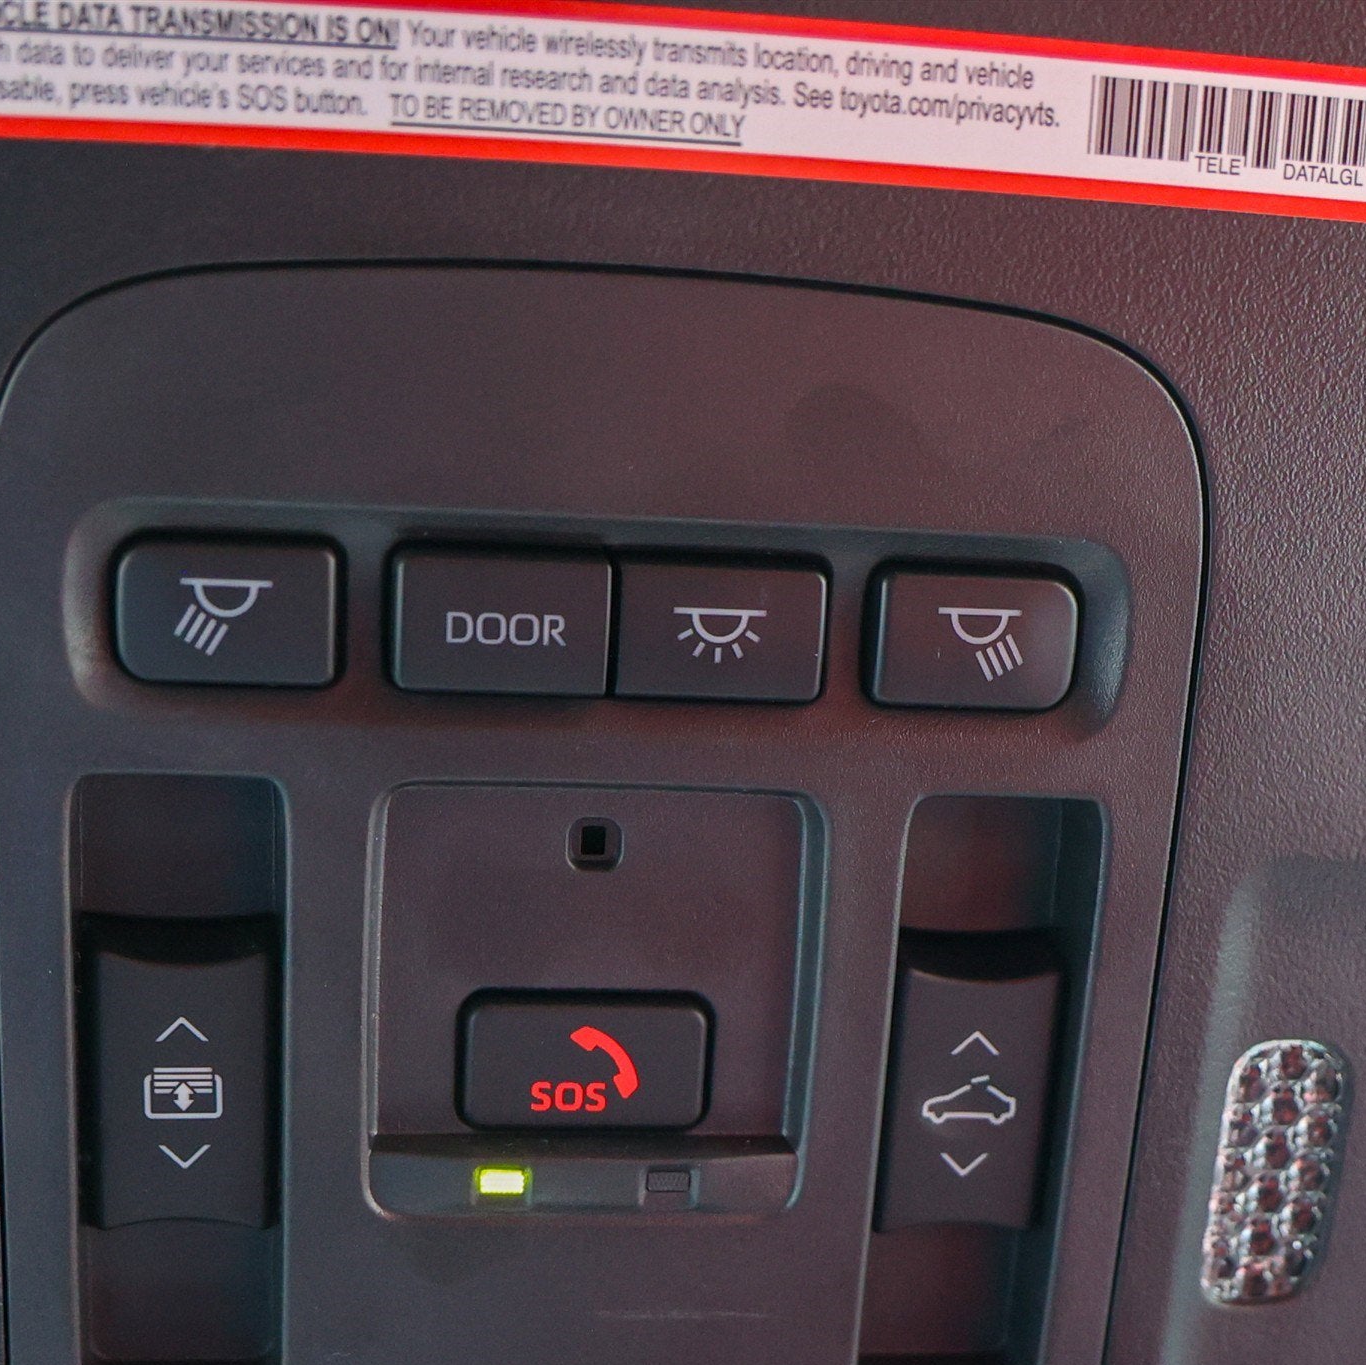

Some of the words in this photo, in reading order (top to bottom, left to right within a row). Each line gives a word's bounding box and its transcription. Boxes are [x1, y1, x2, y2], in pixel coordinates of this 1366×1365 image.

[58, 2, 122, 30] DATA
[131, 5, 319, 40] TRANSMISSION
[327, 14, 348, 42] IS
[407, 19, 456, 48] Your
[461, 23, 536, 52] vehicle
[543, 29, 647, 65] wirelessly
[652, 37, 747, 67] transmits
[753, 42, 838, 77] location,
[846, 51, 912, 86] driving
[920, 59, 957, 83] and
[965, 61, 1034, 90] vehicle
[17, 38, 66, 66] data
[73, 41, 95, 67] to
[101, 42, 175, 69] deliver
[182, 50, 229, 77] your
[238, 53, 325, 77] services
[333, 56, 373, 80] and
[381, 54, 407, 81] for
[415, 57, 494, 86] internal
[501, 65, 593, 94] research
[599, 70, 639, 95] and
[644, 73, 689, 99] data
[697, 76, 784, 109] analysis.
[793, 81, 833, 109] See
[840, 87, 1060, 130] toyota.com/privacyvts.
[68, 82, 129, 110] press
[238, 83, 288, 111] SOS
[294, 86, 368, 116] button.
[390, 92, 419, 118] TO
[425, 95, 452, 120] BE
[458, 96, 567, 126] REMOVED
[572, 103, 600, 128] BY
[604, 105, 685, 134] OWNER
[690, 111, 746, 138] ONLY
[1194, 155, 1241, 176] TELE
[1282, 163, 1364, 188] DATALGL
[446, 611, 566, 646] DOOR
[530, 1081, 606, 1112] SOS
